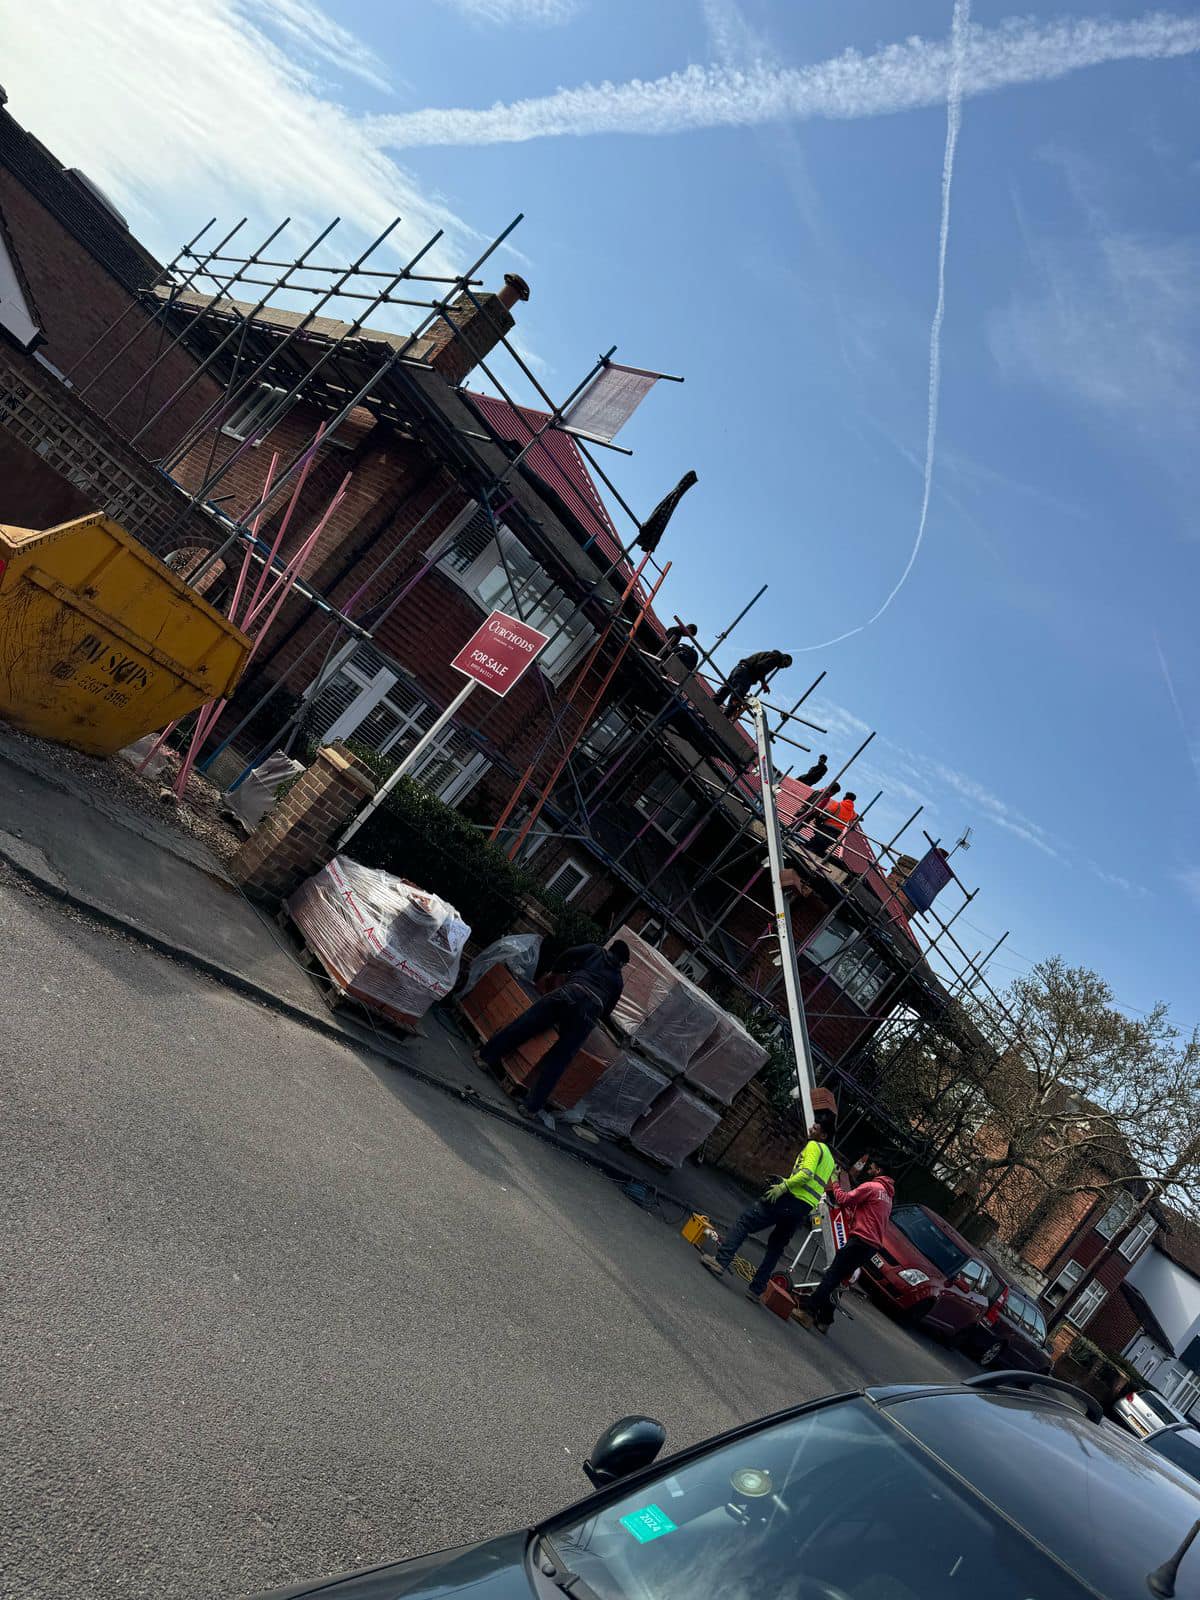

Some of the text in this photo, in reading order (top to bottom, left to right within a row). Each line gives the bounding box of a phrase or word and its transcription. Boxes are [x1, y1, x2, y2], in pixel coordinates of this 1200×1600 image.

[488, 620, 535, 653] CURCHODS
[101, 652, 154, 692] SKIPS
[470, 649, 489, 665] FOR
[485, 657, 509, 677] SALE
[640, 1513, 661, 1532] 2024
